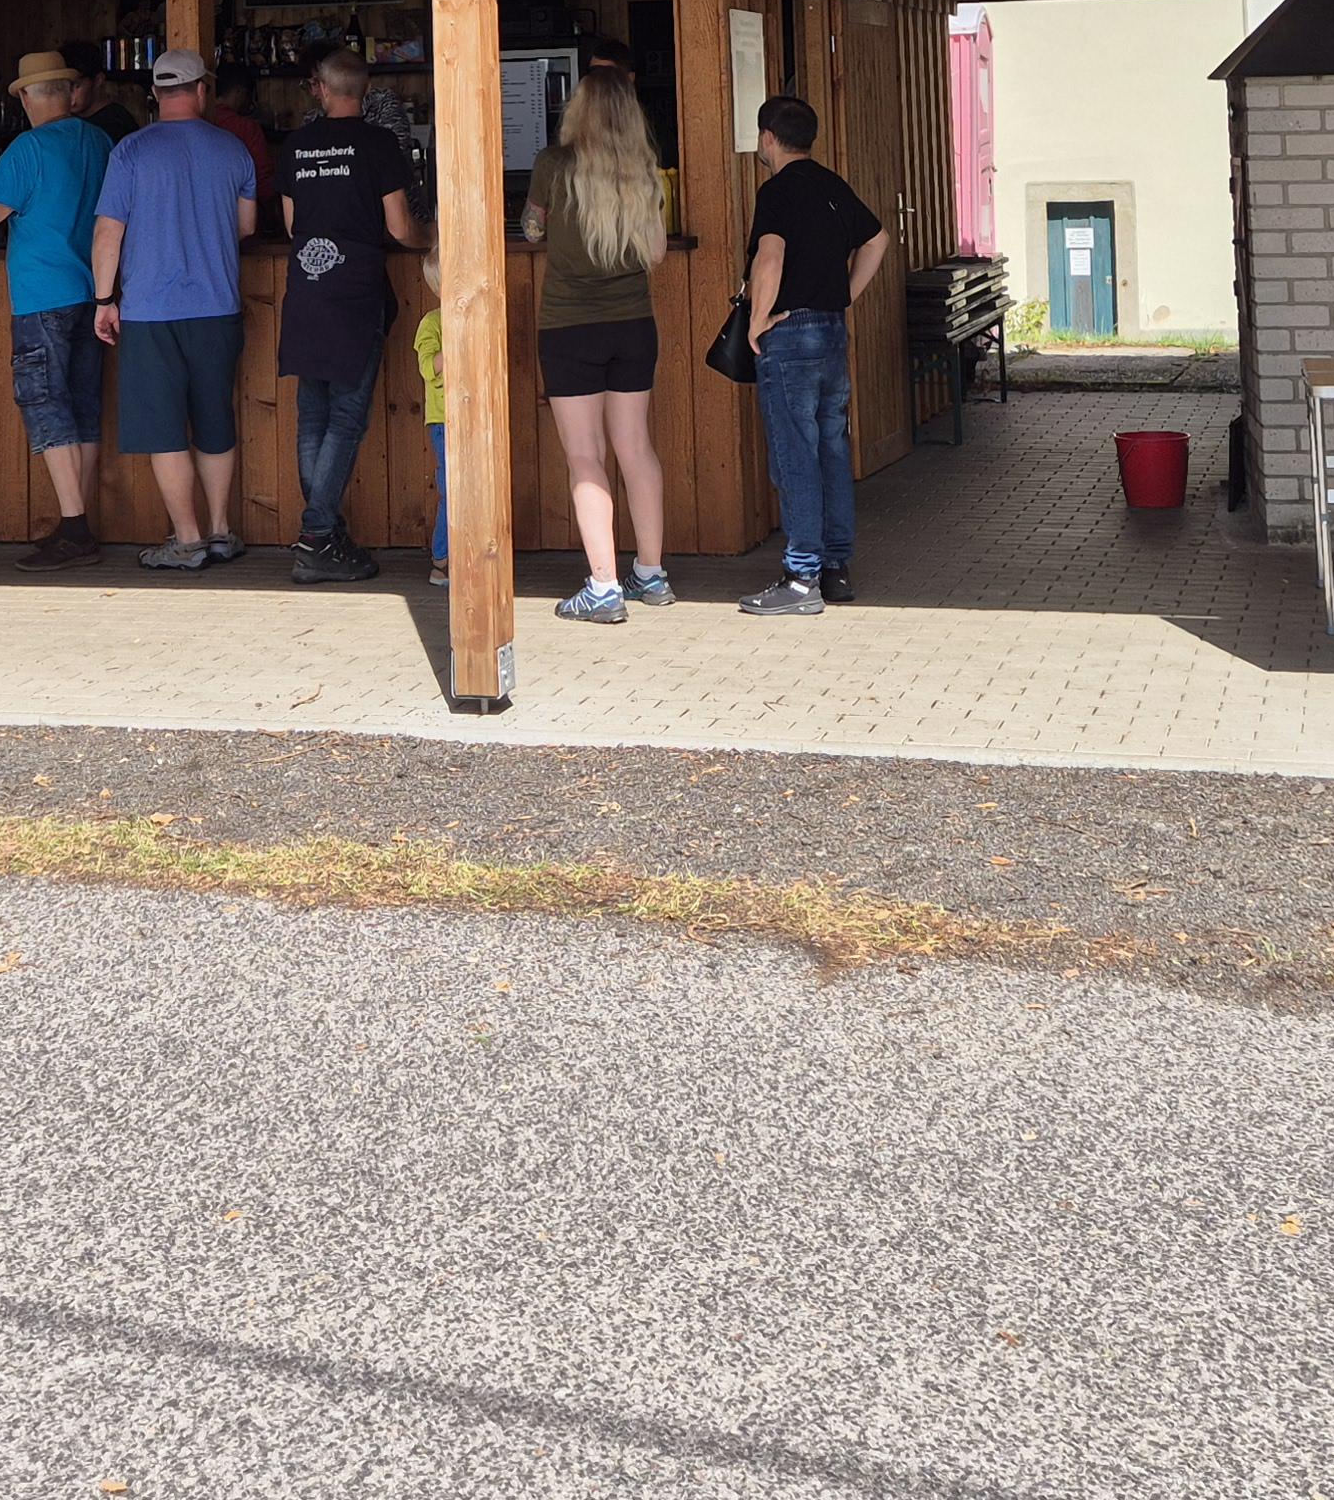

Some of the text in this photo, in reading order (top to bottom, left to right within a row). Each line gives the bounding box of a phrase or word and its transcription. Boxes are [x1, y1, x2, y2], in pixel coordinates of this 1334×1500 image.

[295, 145, 355, 159] Trautenberk
[296, 165, 350, 181] pivo horalů
